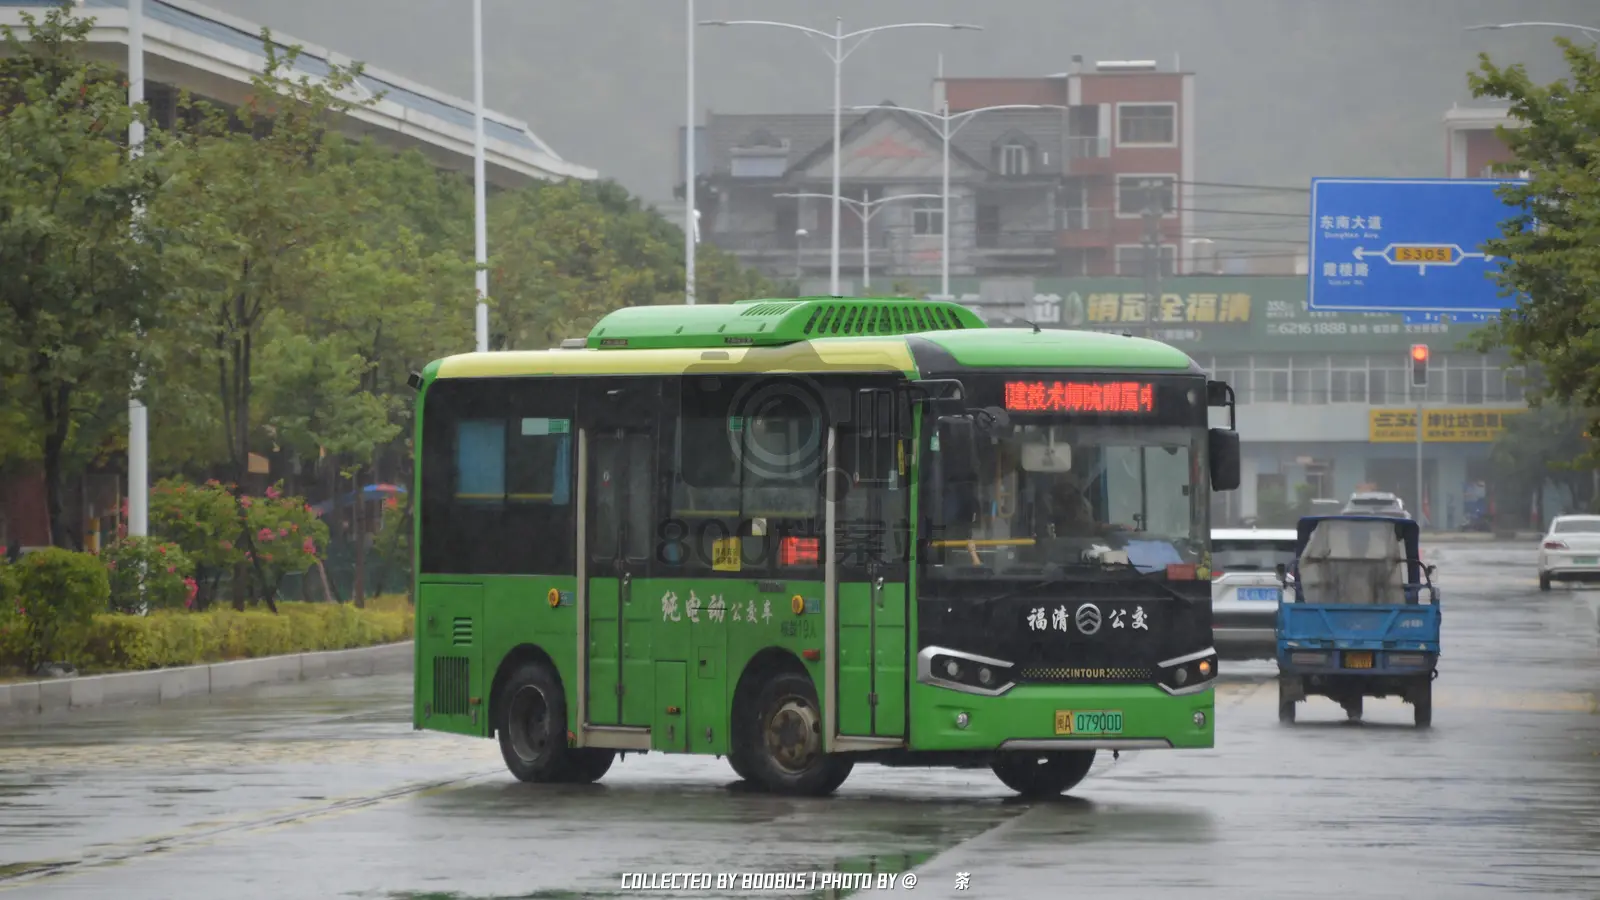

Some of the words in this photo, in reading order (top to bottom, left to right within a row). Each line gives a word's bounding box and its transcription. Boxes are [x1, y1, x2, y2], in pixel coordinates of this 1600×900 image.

[1320, 215, 1383, 230] 东南大道
[1402, 248, 1447, 261] S305
[1027, 605, 1069, 632] 福清
[1108, 606, 1149, 631] 公交
[1070, 668, 1106, 678] INTOUR
